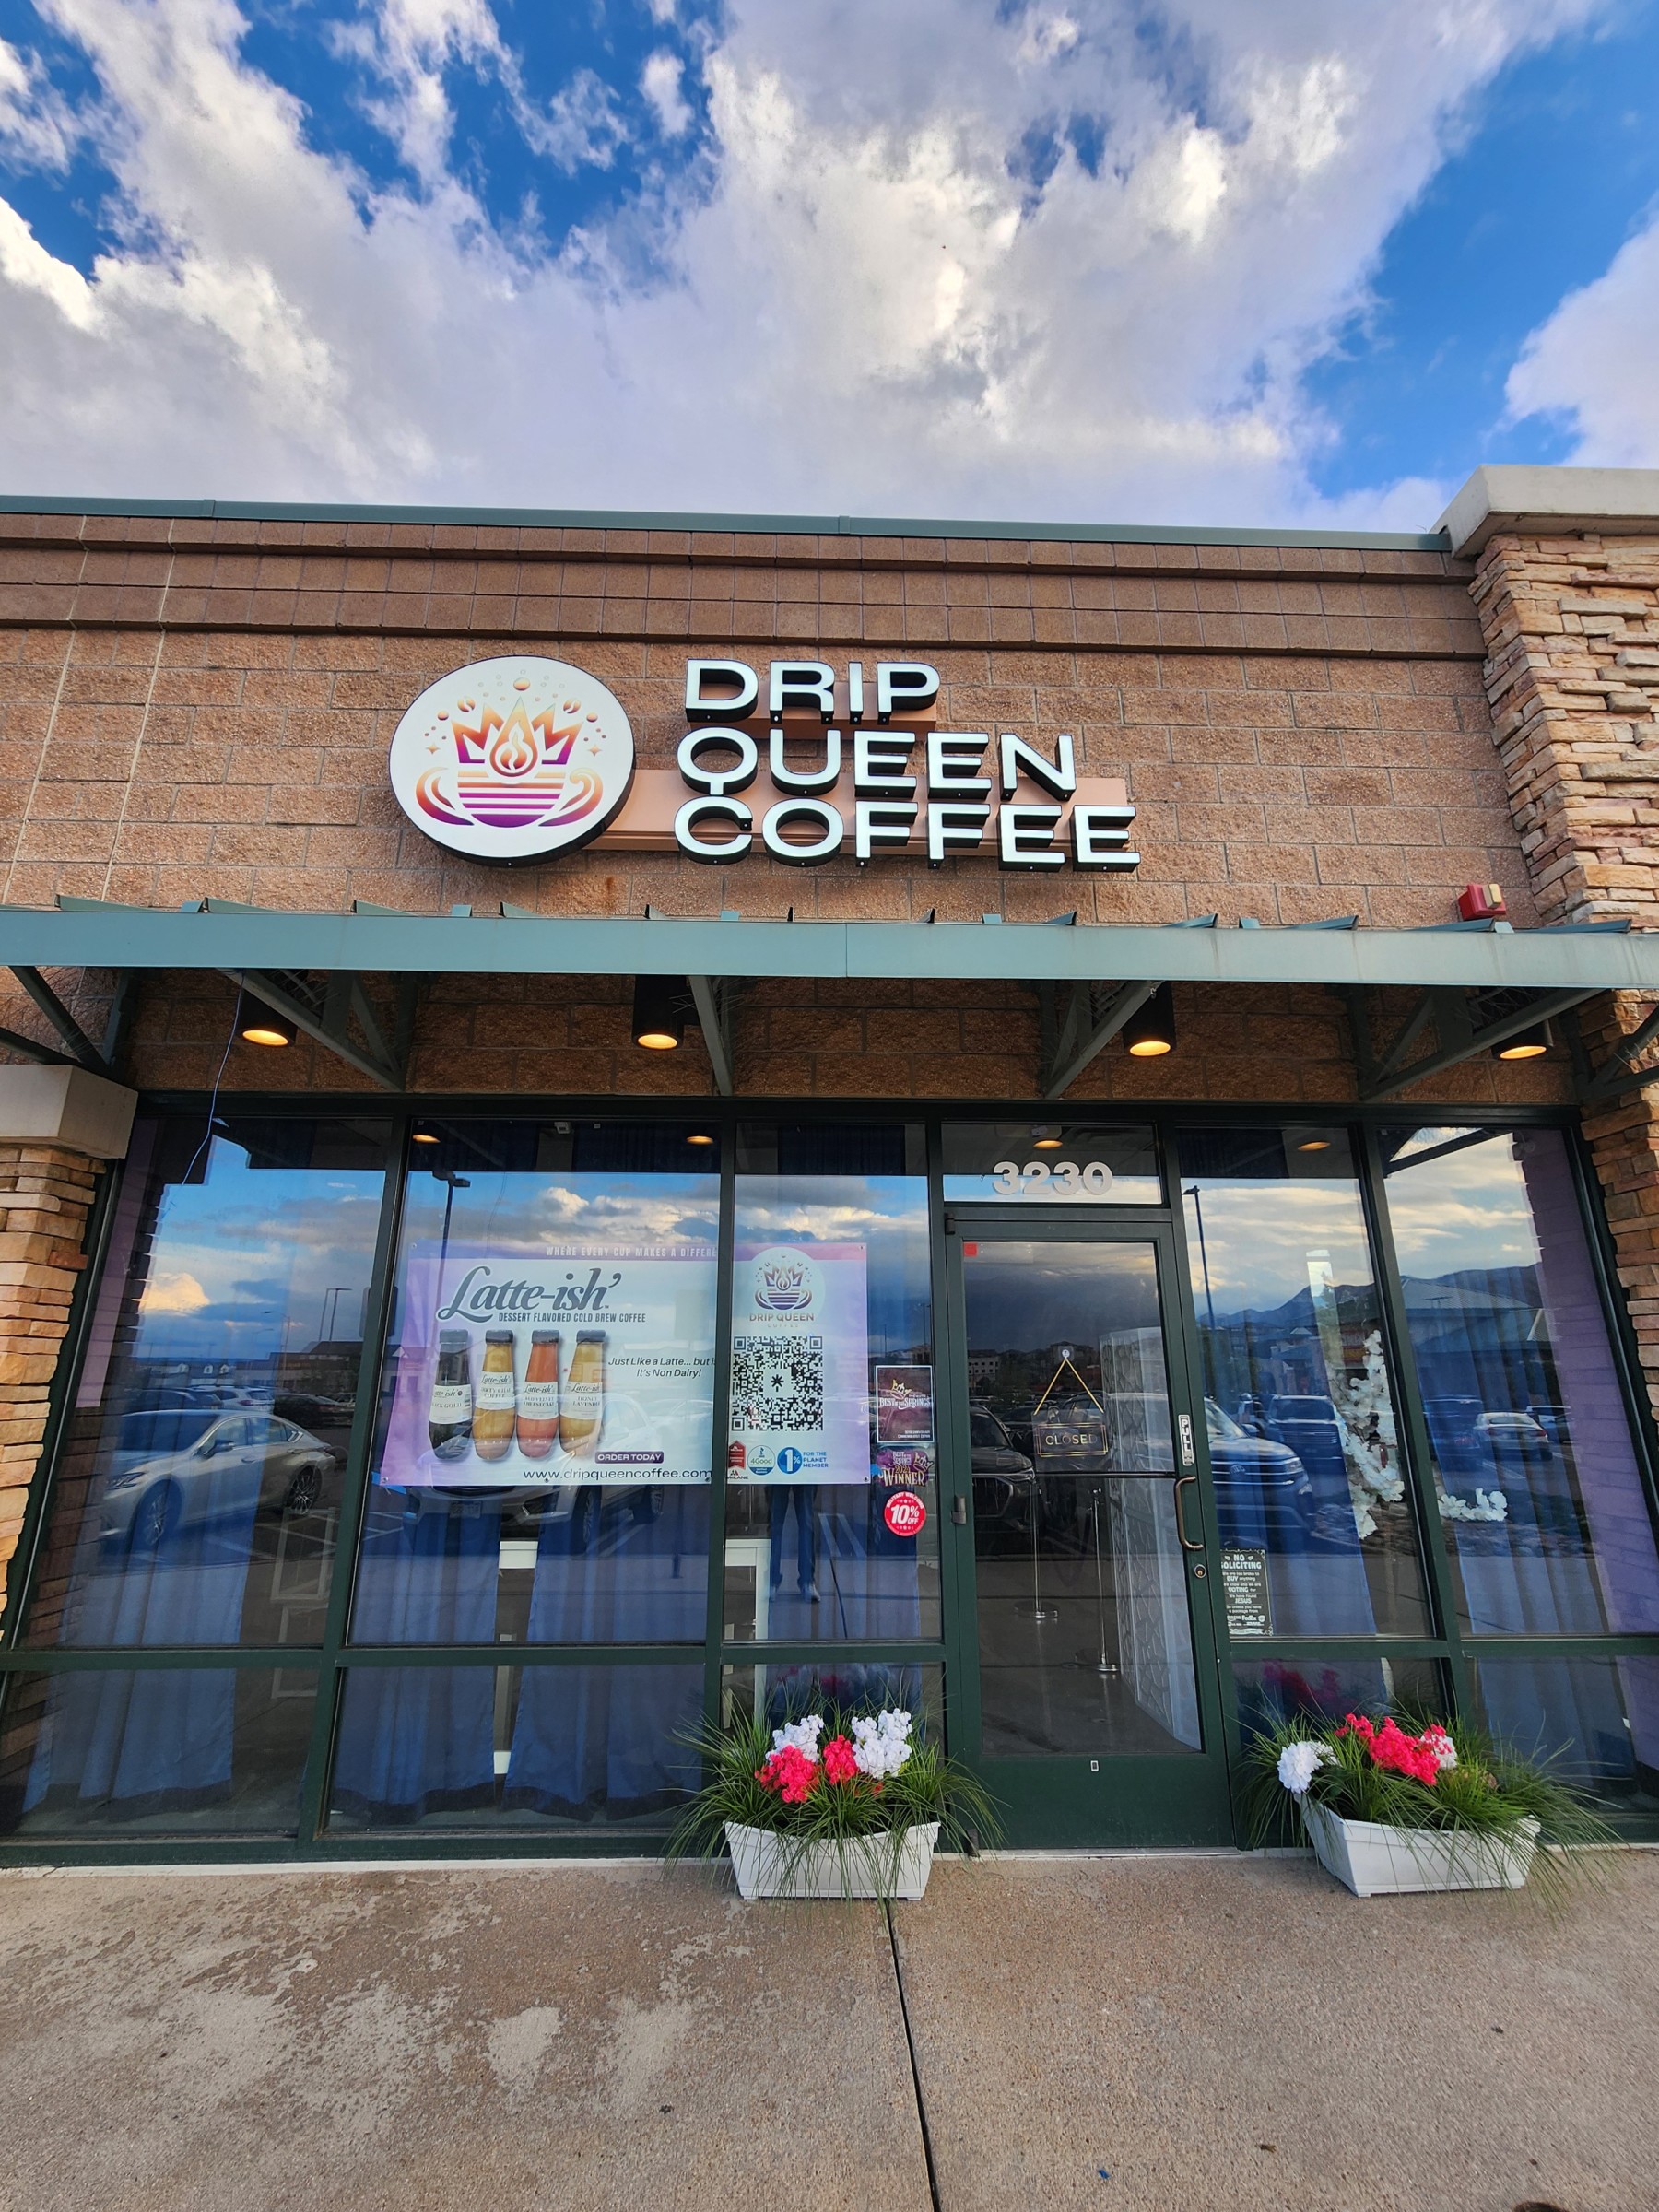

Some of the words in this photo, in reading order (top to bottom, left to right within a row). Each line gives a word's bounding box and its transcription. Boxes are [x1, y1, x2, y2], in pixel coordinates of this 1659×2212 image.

[686, 658, 940, 724] DRIP
[677, 728, 1077, 800] QUEEN
[676, 794, 1141, 871] COFFEE
[993, 1161, 1113, 1195] 3230
[546, 1246, 577, 1256] WHERE
[581, 1246, 609, 1256] EVERY
[614, 1246, 630, 1256] CUP
[635, 1246, 666, 1257] MAKES
[671, 1247, 677, 1257] A
[499, 1313, 531, 1322] DESSERT
[534, 1313, 571, 1322] FLAVORED
[573, 1313, 593, 1322] COLD
[595, 1313, 617, 1322] BREW
[618, 1313, 646, 1323] COFFEE
[749, 1313, 774, 1322] DRIP
[776, 1313, 814, 1322] QUEEN
[608, 1357, 629, 1366] Just
[631, 1357, 651, 1366] Like
[660, 1357, 691, 1366] Latte...
[693, 1357, 711, 1366] but
[637, 1369, 651, 1377] It's
[652, 1369, 672, 1377] Non
[674, 1369, 701, 1379] Dairy!
[1045, 1434, 1098, 1445] CLOSED
[1181, 1419, 1191, 1451] PULL
[524, 1467, 712, 1481] www.dripqueencoffee.com
[878, 1467, 925, 1487] WINNER
[891, 1504, 920, 1524] 10%
